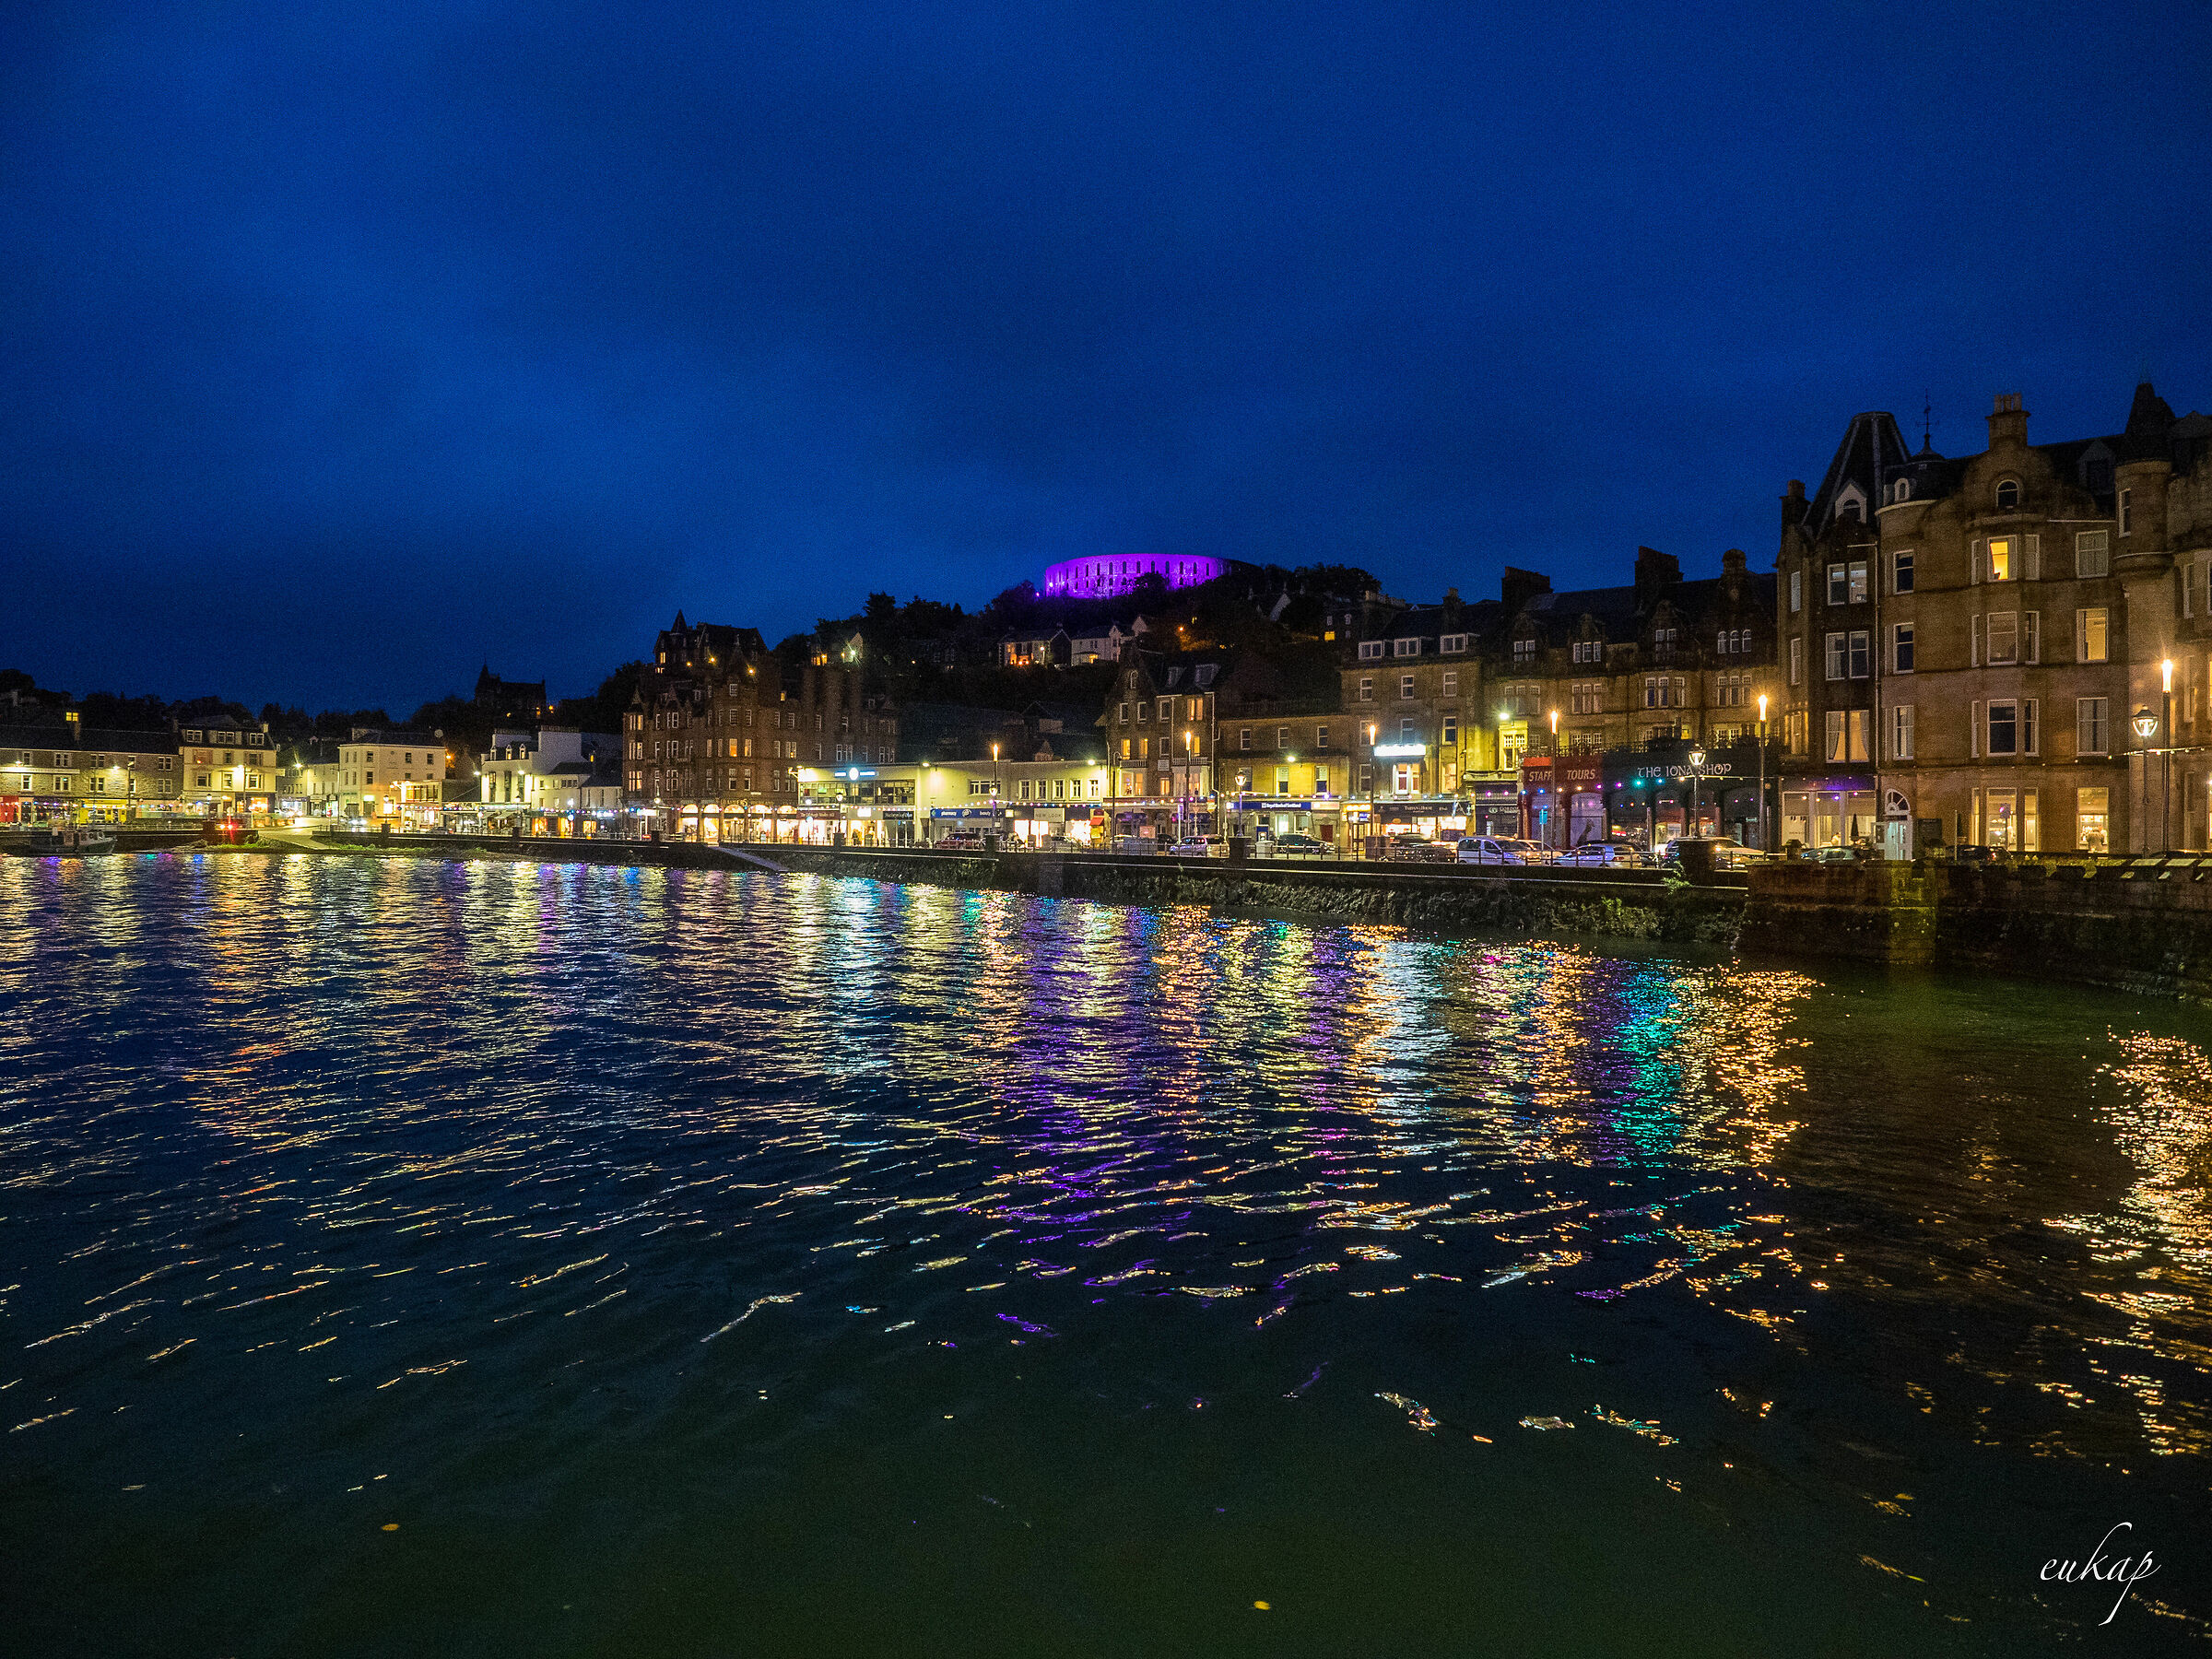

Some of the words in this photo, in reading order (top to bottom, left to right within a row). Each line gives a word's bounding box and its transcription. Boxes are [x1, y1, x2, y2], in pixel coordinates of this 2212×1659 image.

[1529, 770, 1556, 782] STAFF
[1567, 769, 1596, 781] TOURS
[1637, 766, 1662, 778] THE
[1666, 764, 1693, 777] IONA
[1698, 763, 1732, 776] SHOP
